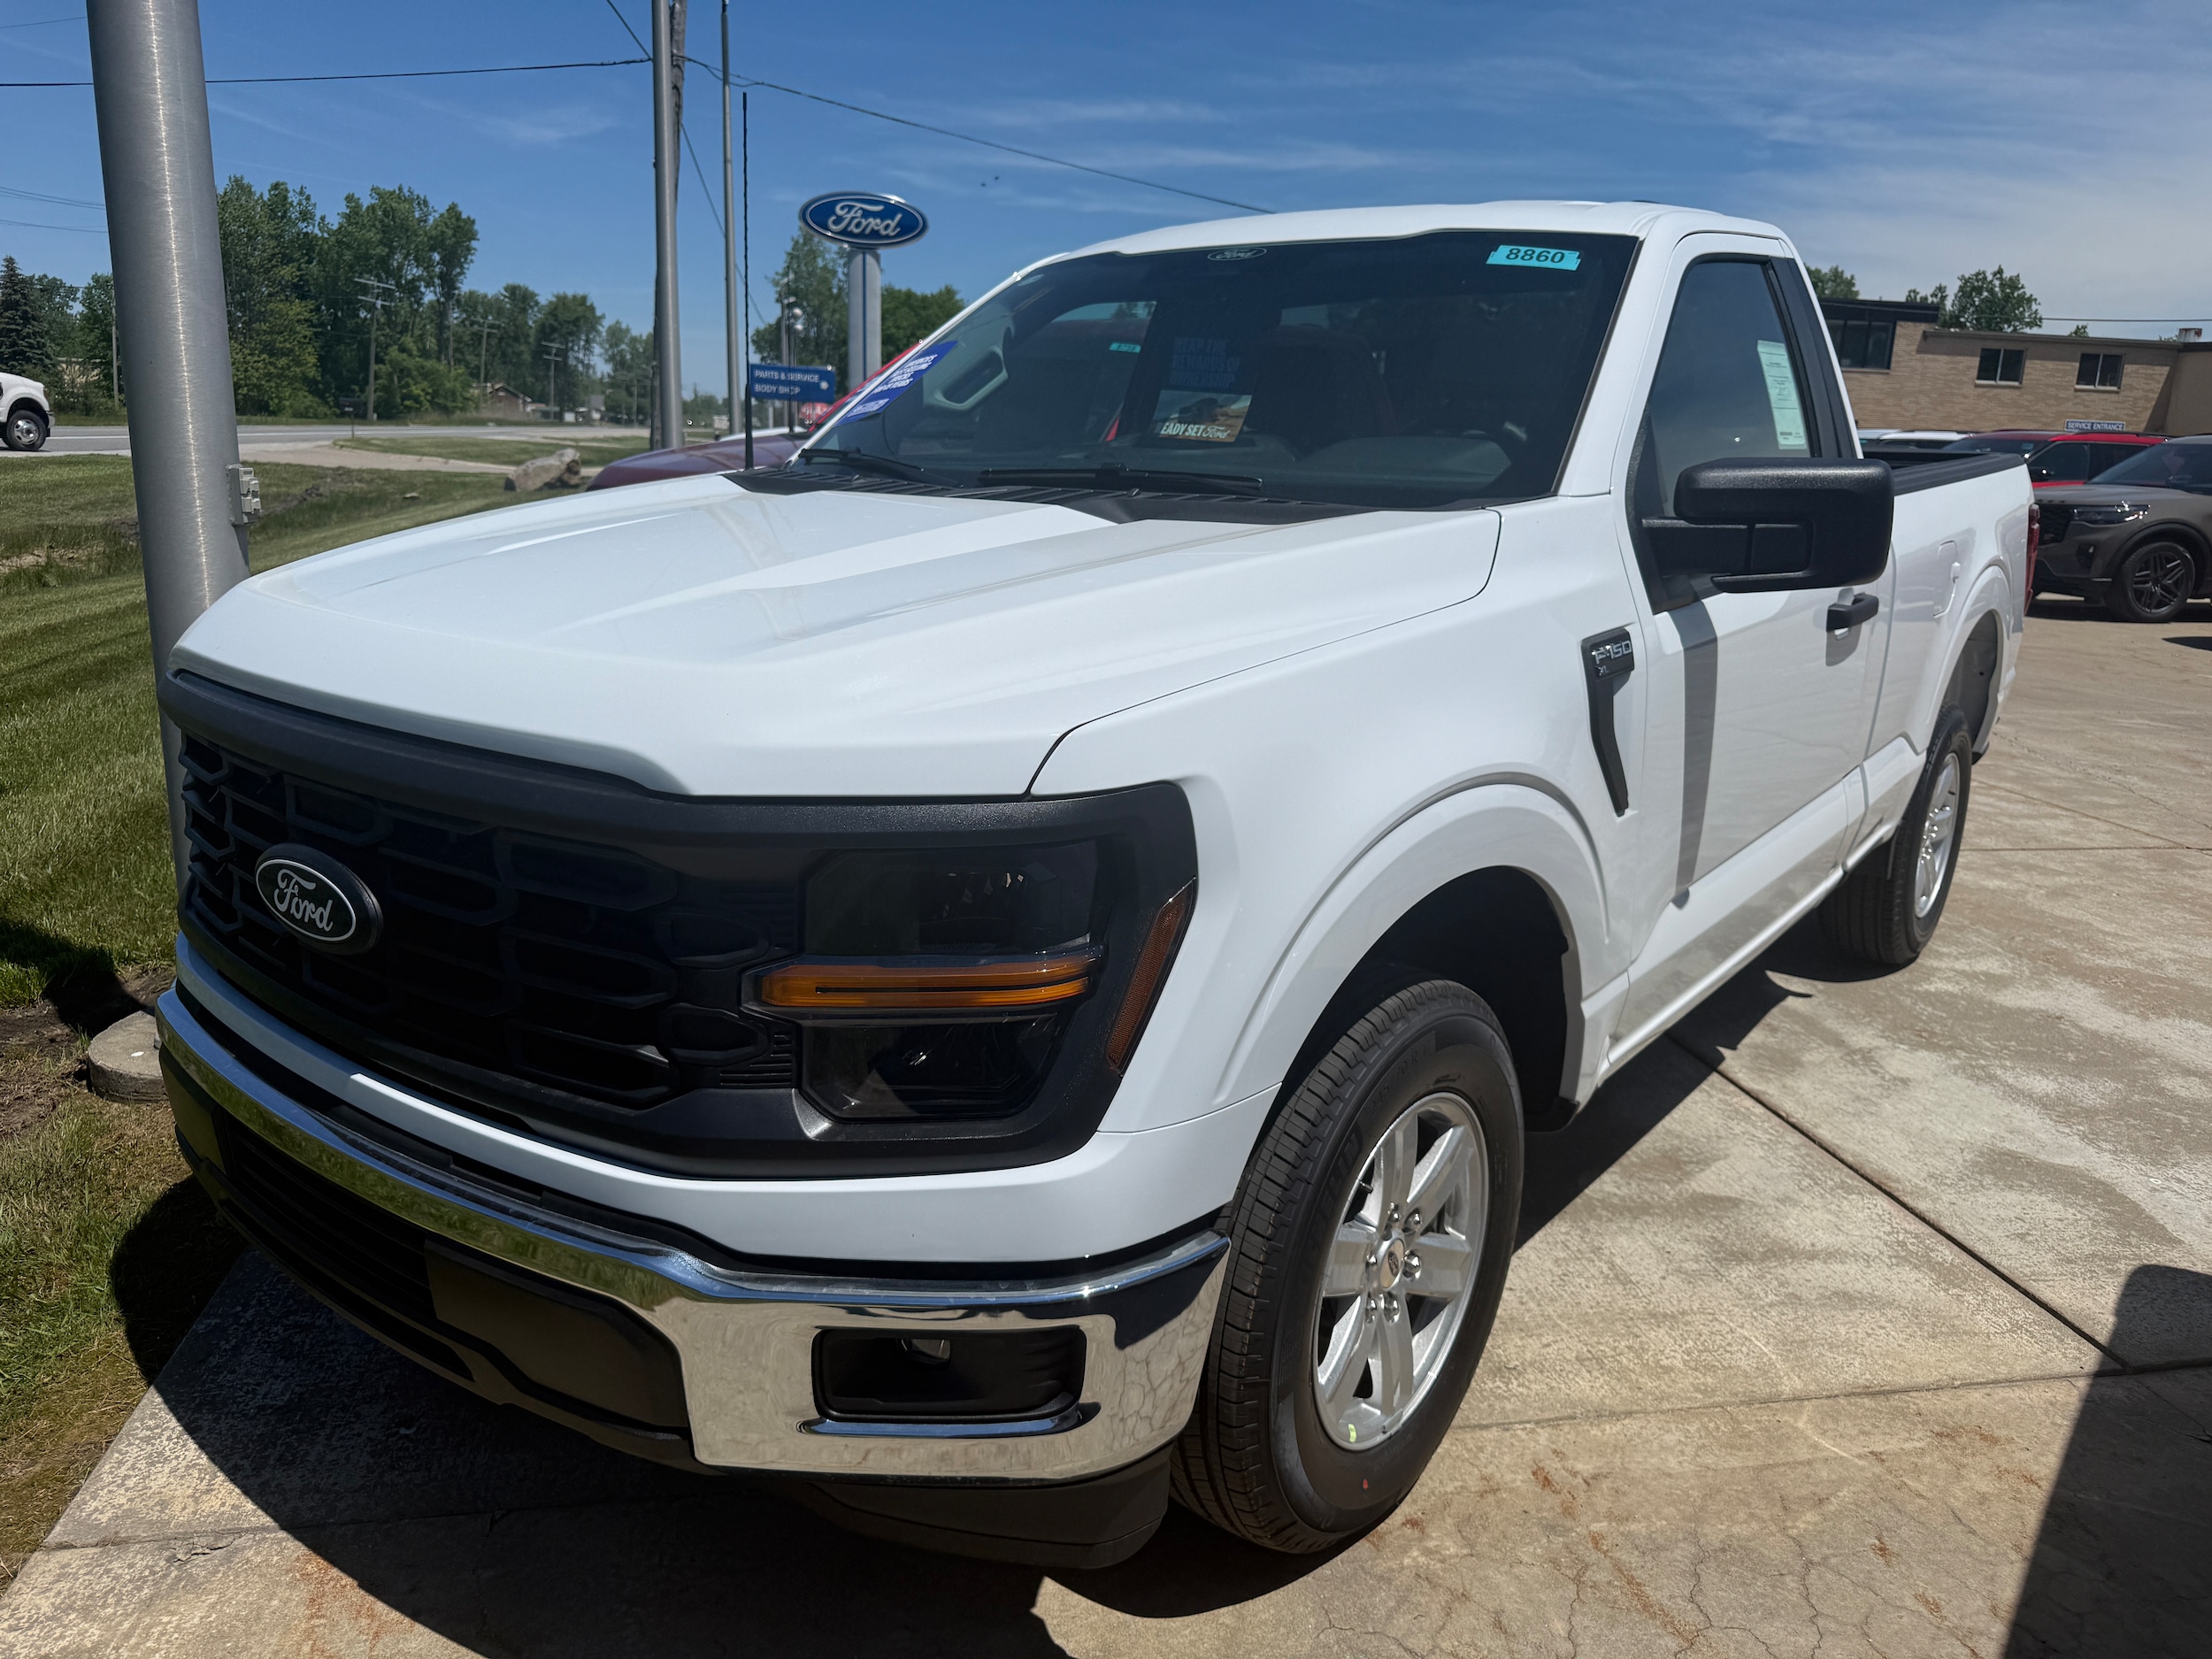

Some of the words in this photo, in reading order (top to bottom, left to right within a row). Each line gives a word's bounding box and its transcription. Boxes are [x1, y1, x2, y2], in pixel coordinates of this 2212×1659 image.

[828, 201, 903, 237] Ford
[1505, 248, 1565, 264] 8860
[755, 370, 779, 380] PARTS
[787, 373, 819, 383] SERVICE
[755, 383, 777, 394] BODY
[1186, 424, 1206, 437] SET
[1202, 426, 1231, 439] Ford
[1594, 640, 1632, 664] F-150
[273, 868, 334, 932] Ford
